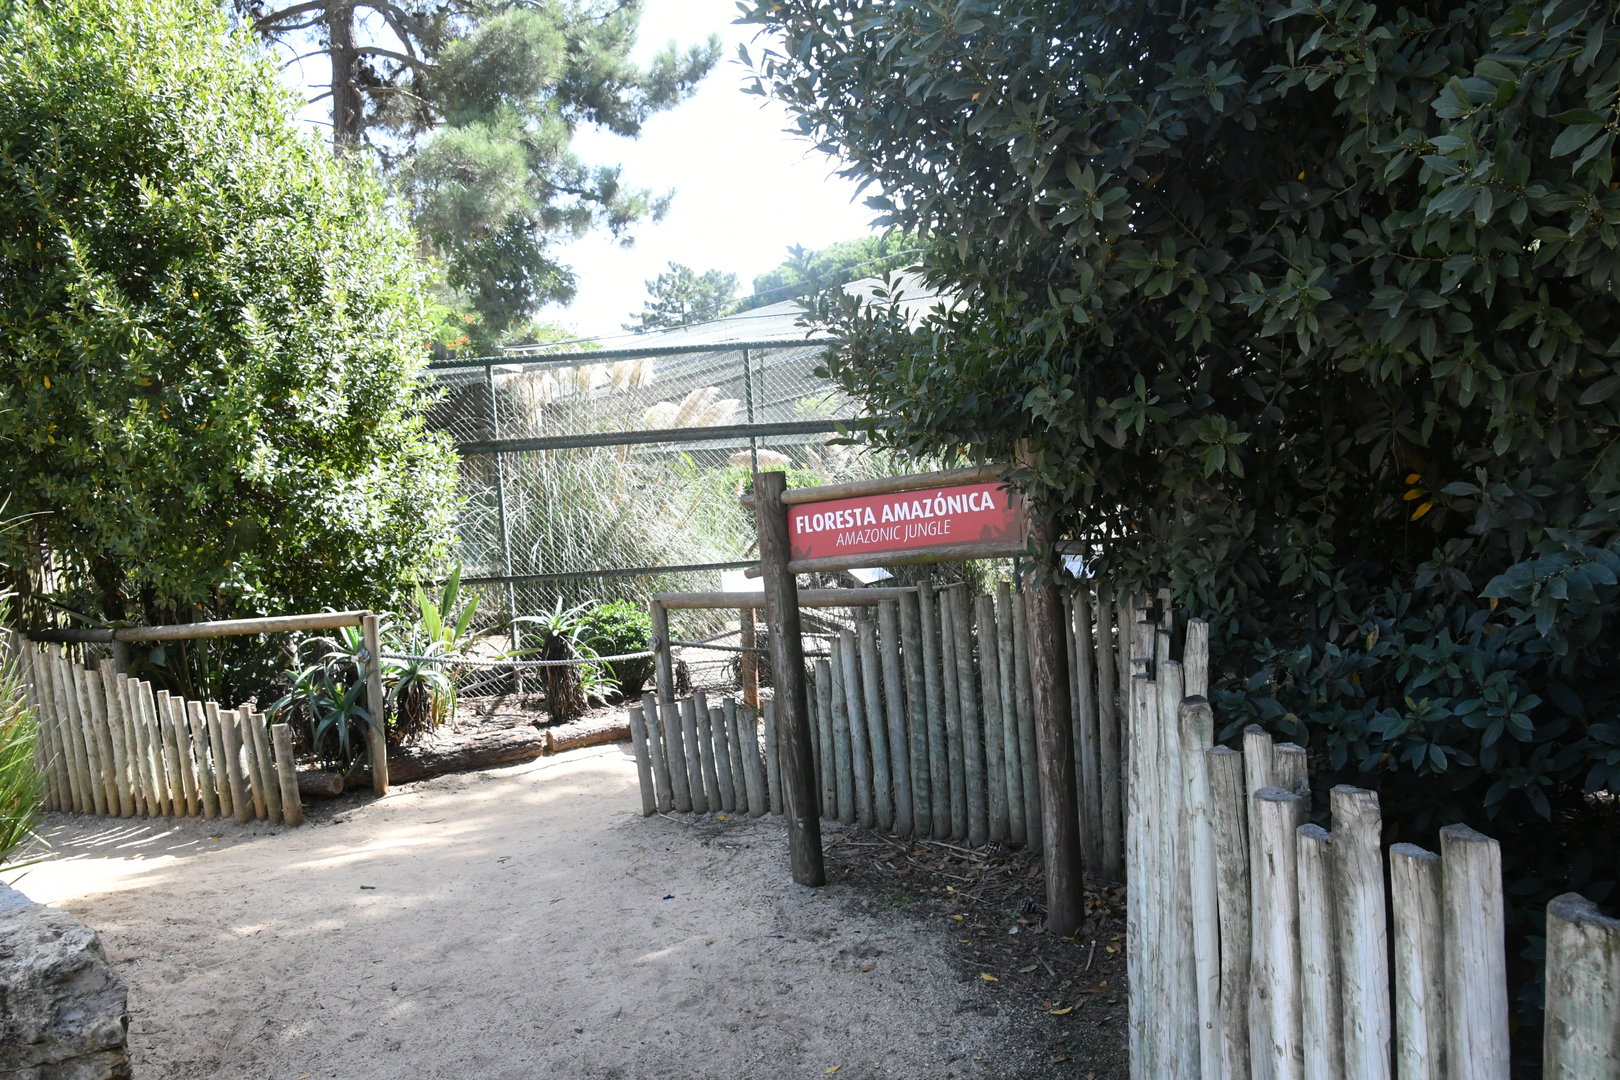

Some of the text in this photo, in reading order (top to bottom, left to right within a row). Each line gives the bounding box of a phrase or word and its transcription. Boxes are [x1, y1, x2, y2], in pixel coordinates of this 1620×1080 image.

[795, 491, 995, 534] FLORESTA AMAZÓNICA
[836, 519, 951, 547] AMAZONIC JUNGLE
